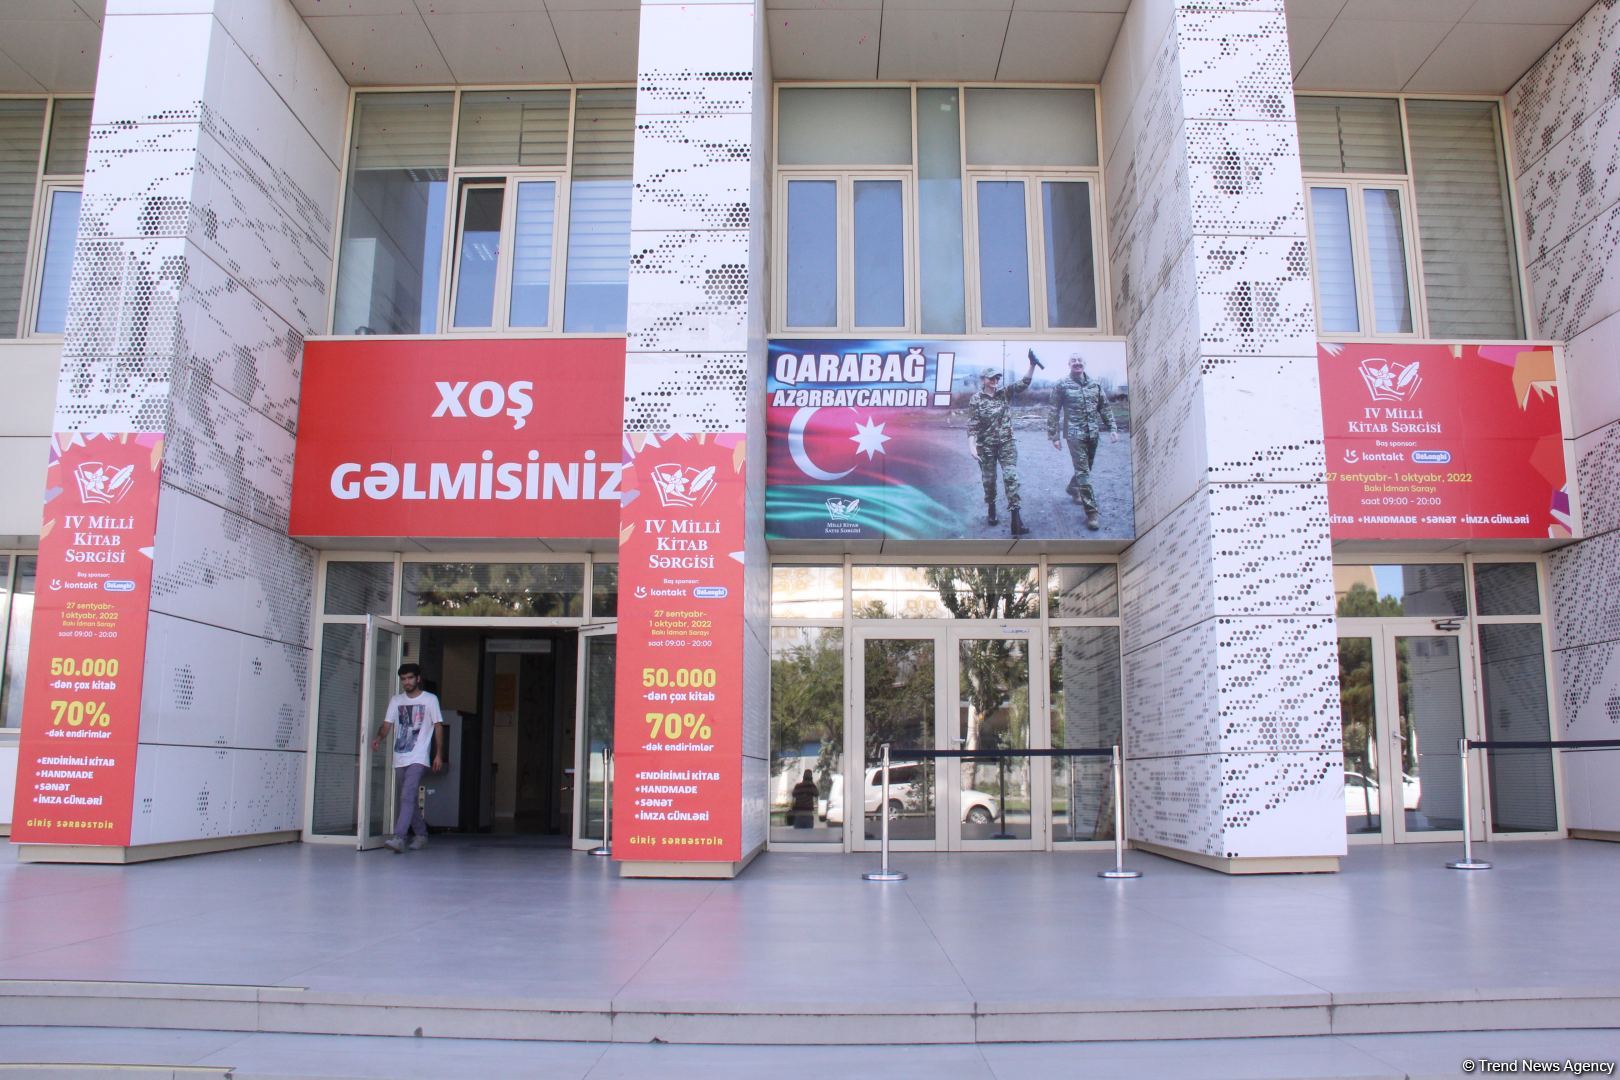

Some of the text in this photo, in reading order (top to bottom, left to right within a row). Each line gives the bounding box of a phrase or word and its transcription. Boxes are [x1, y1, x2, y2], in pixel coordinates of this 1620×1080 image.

[775, 348, 926, 386] QARABAĞ
[772, 389, 929, 408] AZƏRBAYCANDIR
[432, 380, 534, 430] XOŞ
[1364, 408, 1423, 419] IV MİLLİ
[1348, 421, 1442, 433] KİTAB SƏRGİSİ
[1362, 452, 1404, 460] kontakt
[330, 450, 622, 500] GƏLMİSİNİZ
[1447, 473, 1472, 482] 2022
[1416, 497, 1441, 505] 20:00
[64, 516, 134, 530] IV MİLLİ
[1364, 516, 1417, 524] HANDMADE
[1426, 516, 1457, 524] SƏNƏT
[1466, 514, 1491, 524] İMZA
[1491, 514, 1530, 524] GÜNLƏRİ
[644, 520, 720, 534] IV MİLLİ
[73, 532, 121, 546] KİTAB
[656, 537, 708, 551] KİTAB
[65, 549, 126, 563] SƏRGİSİ
[649, 554, 715, 568] SƏRGİSİ
[50, 658, 119, 677] 50.000
[642, 668, 716, 688] 50.000
[74, 682, 90, 692] çox
[92, 680, 116, 690] kitab
[670, 693, 686, 704] çox
[688, 692, 715, 702] kitab
[50, 700, 110, 727] 70%
[646, 712, 712, 740] 70%
[66, 730, 112, 739] endirimlər
[664, 742, 714, 752] endirimlər
[42, 755, 115, 766] ENDİRİMLİ KİTAB
[41, 770, 94, 780] HANDMADE
[640, 770, 720, 780] ENDİRİMLİ KİTAB
[40, 783, 70, 792] SƏNƏT
[640, 785, 698, 794] HANDMADE
[38, 793, 103, 806] İMZA GÜNLƏRİ
[640, 798, 673, 807] SƏNƏT
[640, 810, 709, 821] İMZA GÜNLƏRİ
[27, 818, 114, 830] GİRİŞ SƏRBƏSTDİR
[630, 836, 723, 846] GİRİŞ SƏRBƏSTDİR
